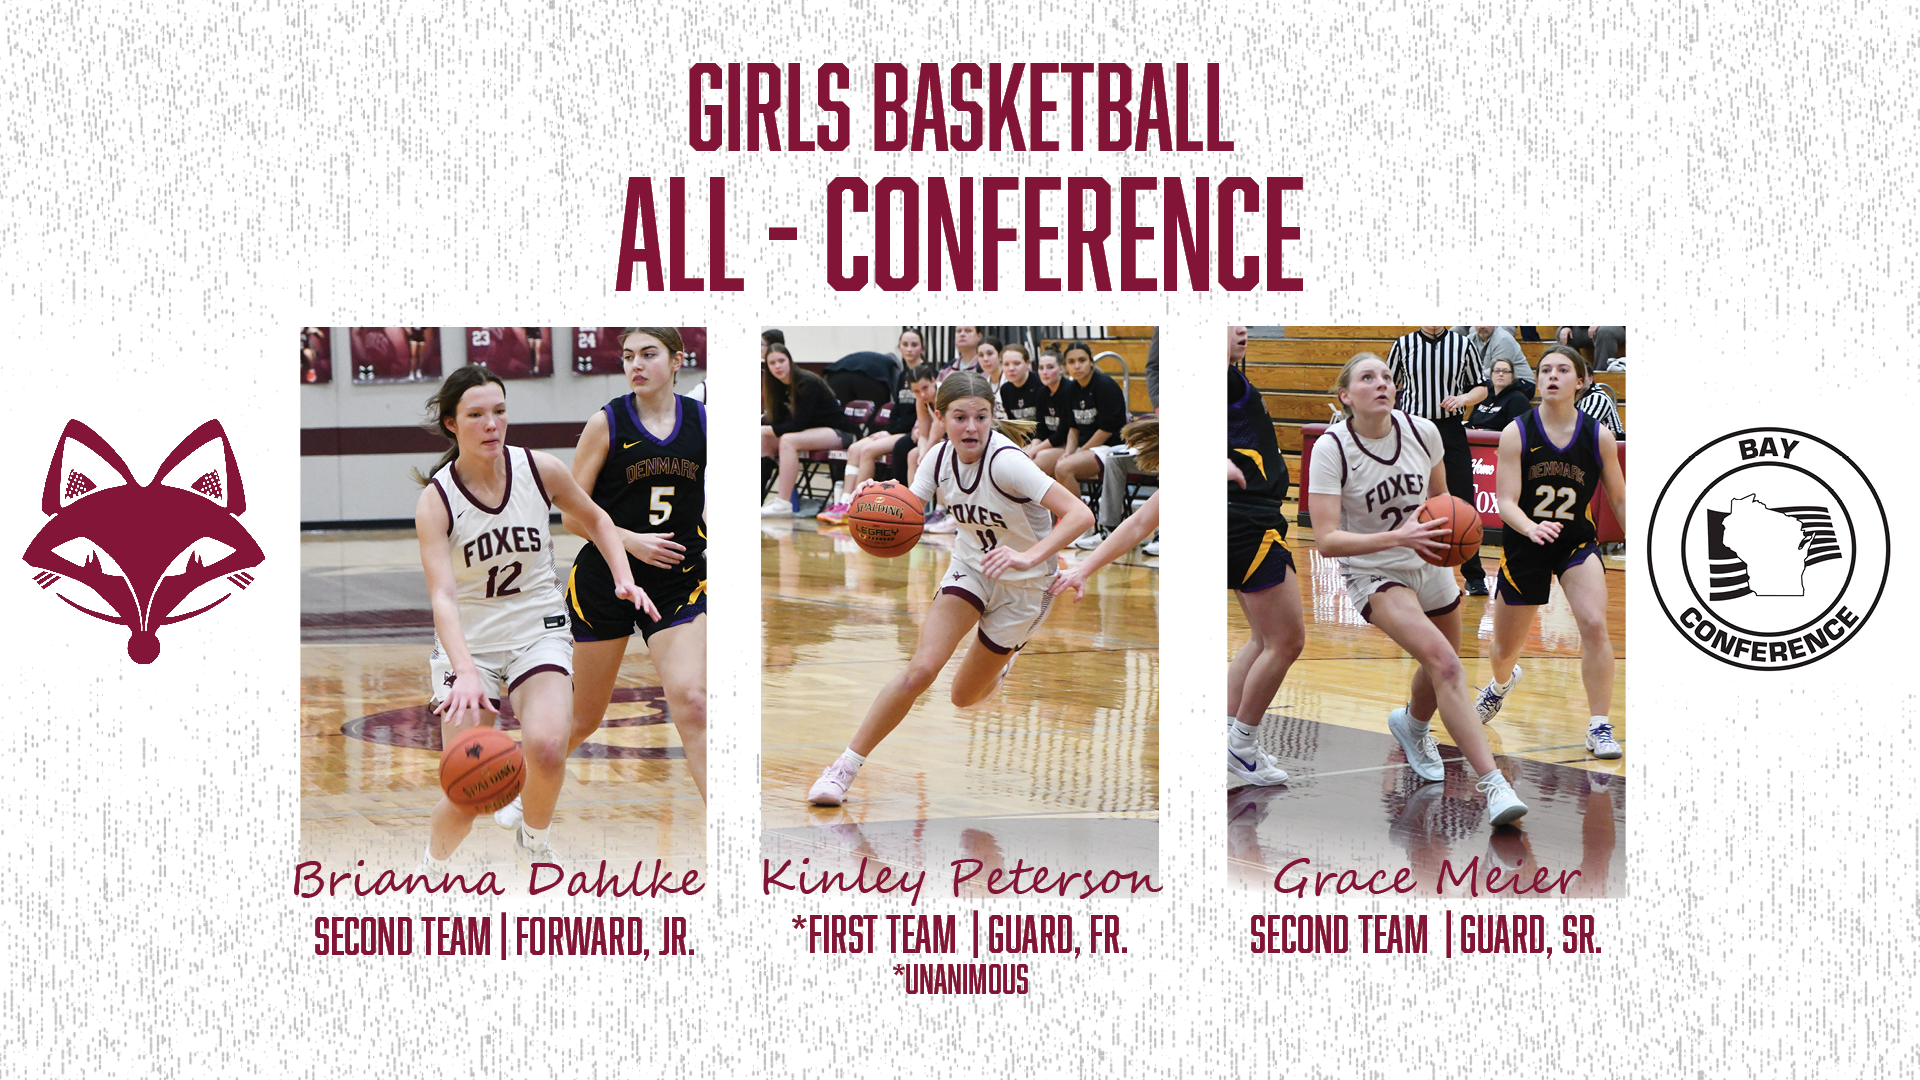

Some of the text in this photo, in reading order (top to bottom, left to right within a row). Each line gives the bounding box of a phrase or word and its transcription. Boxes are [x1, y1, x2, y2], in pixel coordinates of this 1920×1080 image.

[472, 330, 490, 346] 23
[578, 333, 596, 348] 24
[626, 457, 699, 484] DENMARK
[1528, 461, 1586, 486] DENMARK
[649, 486, 675, 526] 5
[856, 502, 905, 520] SPALDING
[1533, 485, 1577, 521] 22
[856, 524, 899, 536] LEGACY
[1380, 504, 1421, 532] 2
[463, 526, 542, 568] FOXES
[976, 529, 998, 554] 11
[486, 561, 522, 598] 12
